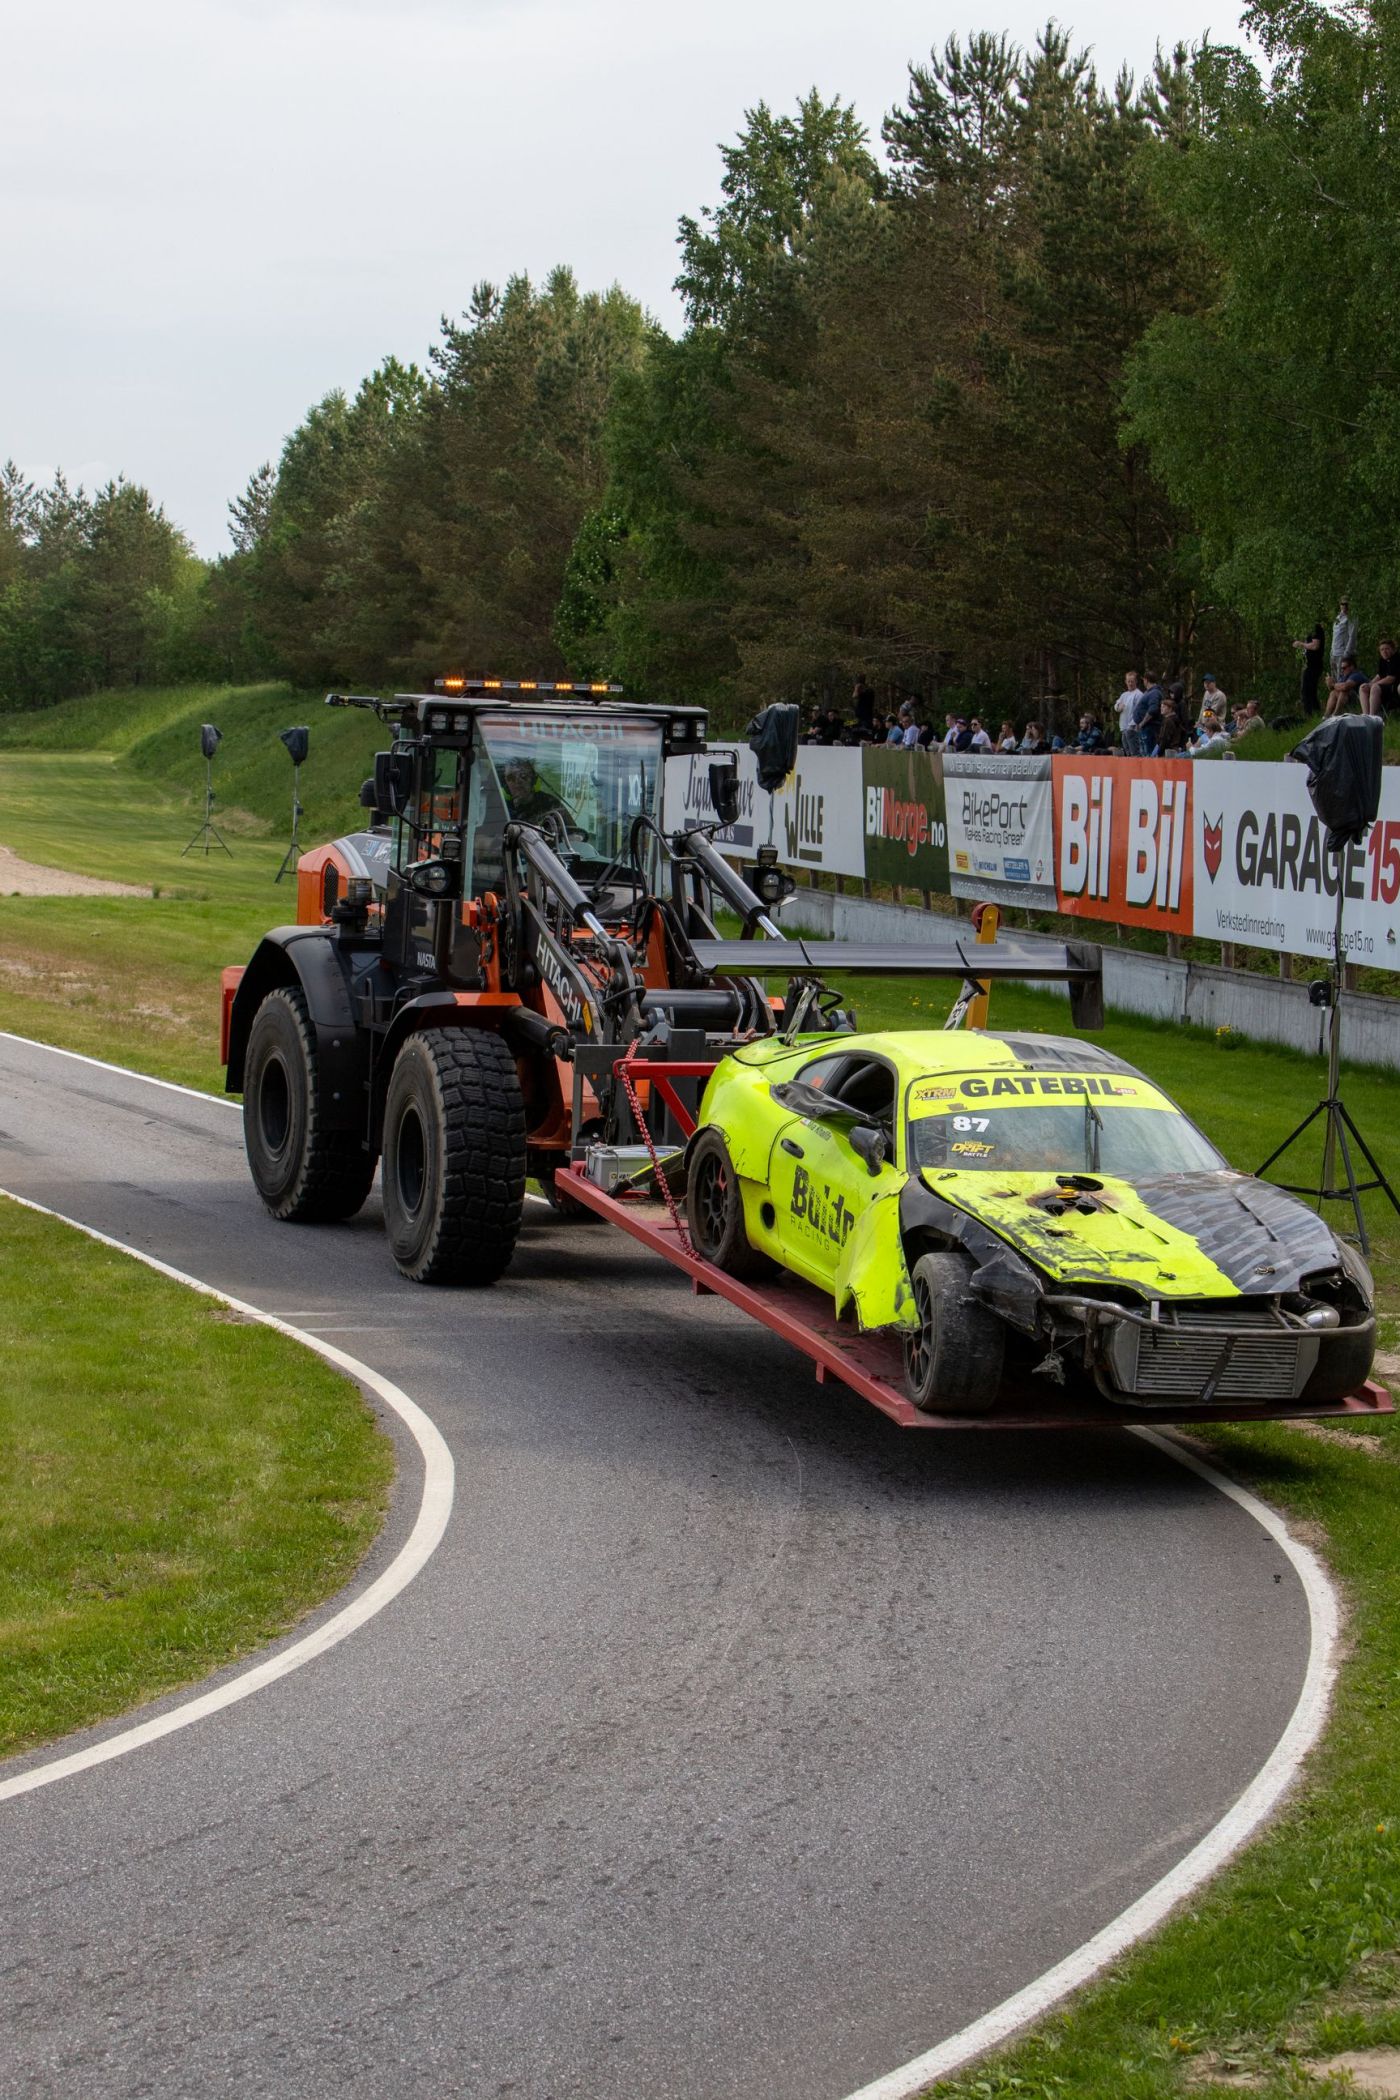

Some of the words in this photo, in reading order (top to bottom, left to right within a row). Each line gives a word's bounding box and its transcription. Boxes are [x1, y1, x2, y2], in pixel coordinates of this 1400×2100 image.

[518, 720, 624, 740] HITACHI
[866, 785, 945, 857] BilNorge.no
[962, 792, 1028, 829] BikePort
[1060, 774, 1112, 899] Bil
[1126, 778, 1188, 911] Bil
[1216, 909, 1285, 943] Verkstedinnredning
[1306, 927, 1374, 953] www.gaage15.no
[417, 952, 436, 969] NASTA
[536, 934, 581, 1022] HITACHI
[914, 1088, 957, 1099] XTRM
[952, 1116, 990, 1133] 87
[951, 1143, 995, 1154] DRIFT
[790, 1215, 830, 1251] RACING
